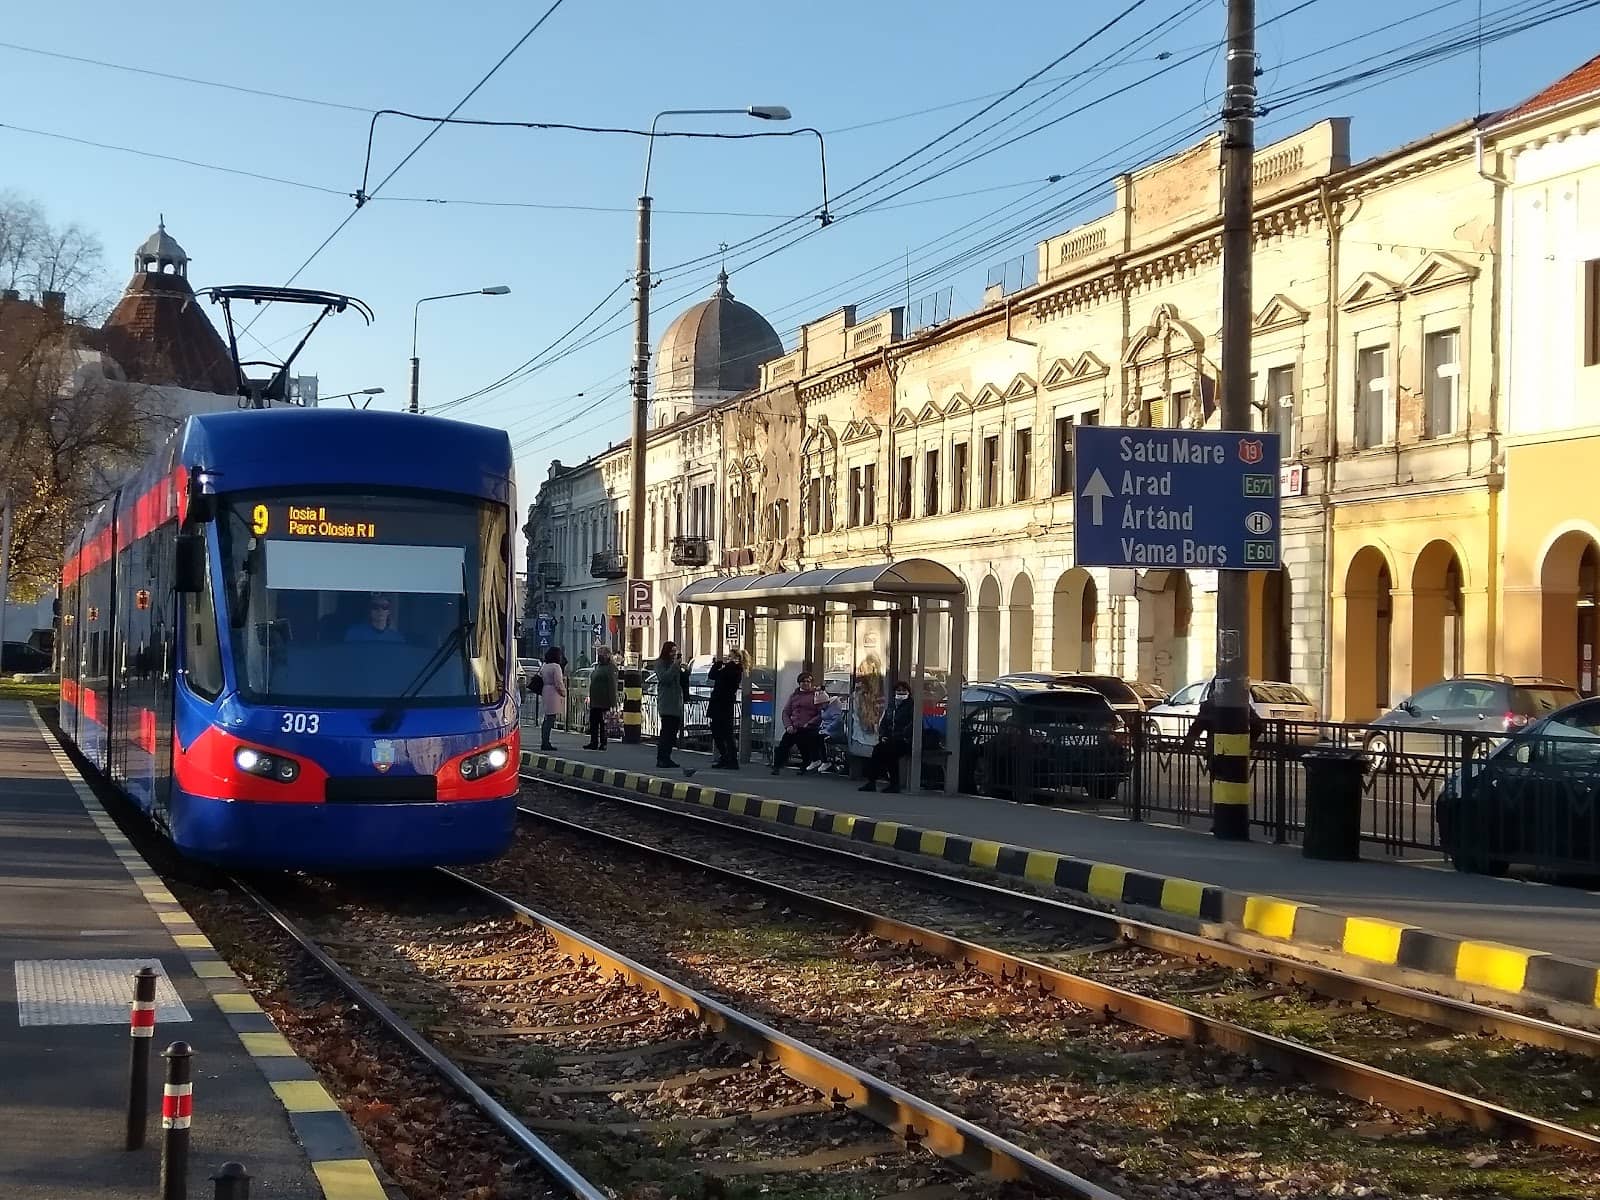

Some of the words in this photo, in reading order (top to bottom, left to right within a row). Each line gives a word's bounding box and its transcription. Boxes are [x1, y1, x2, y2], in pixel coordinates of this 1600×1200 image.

[1120, 436, 1168, 463] Satu
[1173, 438, 1225, 464] Mare
[1244, 444, 1257, 460] 19
[1121, 470, 1171, 496] Arad
[1245, 477, 1273, 495] E671
[253, 504, 269, 534] 9
[289, 506, 317, 521] Iosia
[1121, 500, 1193, 531] Ártánd
[1254, 515, 1263, 531] H
[289, 521, 316, 535] Parc
[357, 523, 367, 537] R
[1121, 538, 1177, 563] Vama
[1247, 543, 1273, 560] E60
[634, 587, 649, 609] P
[281, 712, 320, 734] 303
